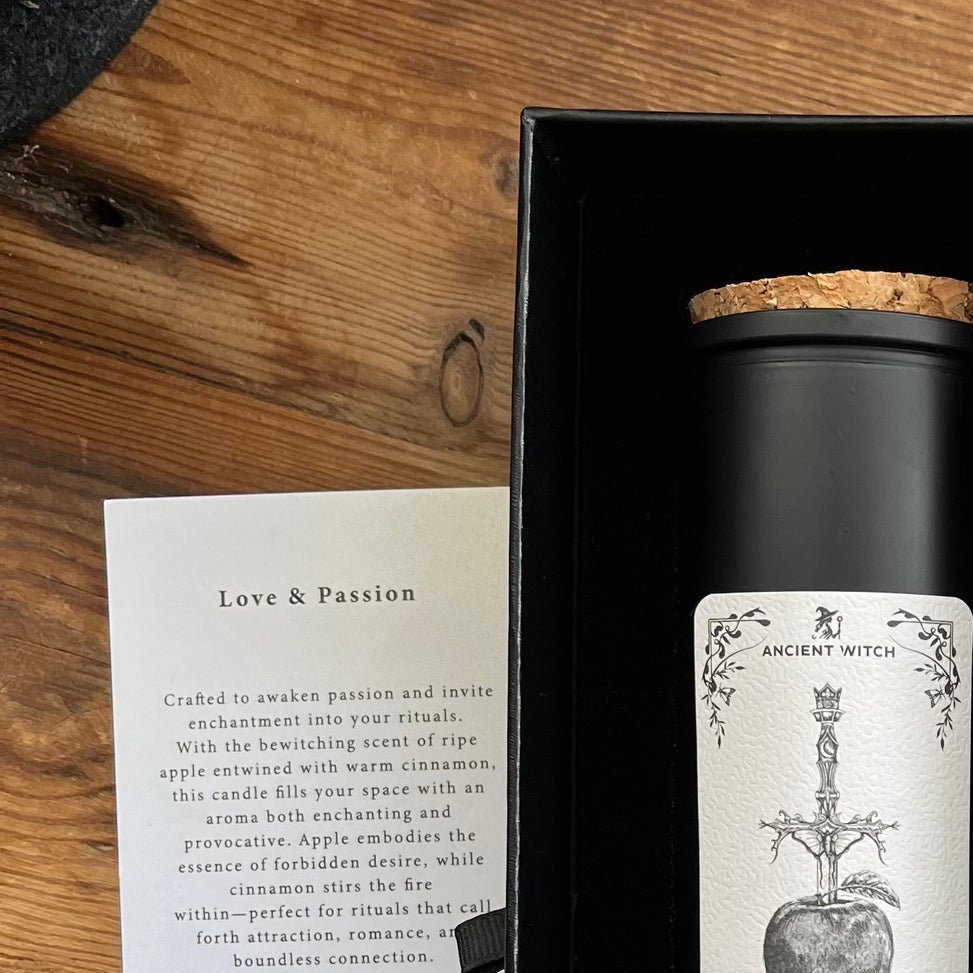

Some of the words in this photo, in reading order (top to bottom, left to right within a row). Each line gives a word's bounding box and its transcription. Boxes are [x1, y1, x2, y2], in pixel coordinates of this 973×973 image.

[218, 590, 277, 608] Love
[288, 587, 306, 605] &
[317, 584, 416, 604] Passion
[761, 644, 835, 657] ANCIENT
[839, 644, 896, 659] WITCH
[163, 690, 226, 707] Crafted
[233, 693, 250, 705] to
[257, 688, 320, 704] awaken
[328, 687, 394, 706] passion
[402, 684, 434, 699] and
[442, 684, 493, 699] invite
[188, 714, 300, 730] enchantment
[308, 713, 343, 726] into
[350, 714, 391, 729] your
[398, 708, 463, 724] rituals.
[175, 739, 217, 754] With
[224, 738, 252, 753] the
[258, 735, 356, 754] bewitching
[363, 735, 409, 749] scent
[416, 732, 436, 747] of
[441, 733, 477, 750] ripe
[159, 763, 206, 781] apple
[213, 760, 293, 777] entwined
[300, 759, 338, 774] with
[345, 762, 394, 773] warm
[401, 758, 496, 772] cinnamon,
[172, 788, 205, 802] this
[211, 785, 268, 801] candle
[275, 784, 307, 799] fills
[314, 787, 355, 802] your
[362, 785, 410, 801] space
[417, 780, 456, 795] with
[464, 783, 484, 794] an
[206, 814, 259, 825] aroma
[265, 808, 305, 824] both
[313, 806, 413, 824] enchanting
[419, 804, 452, 819] and
[184, 834, 292, 854] provocative.
[298, 831, 349, 850] Apple
[356, 829, 441, 845] embodies
[448, 827, 476, 843] the
[178, 862, 243, 874] essence
[249, 856, 268, 872] of
[273, 855, 360, 871] forbidden
[368, 854, 428, 869] desire,
[435, 851, 484, 866] while
[229, 882, 315, 896] cinnamon
[323, 880, 361, 894] stirs
[369, 877, 396, 892] the
[404, 876, 433, 892] fire
[318, 903, 344, 918] for
[351, 901, 409, 917] rituals
[417, 900, 452, 915] that
[459, 898, 491, 914] call
[196, 929, 240, 945] forth
[247, 928, 341, 944] attraction,
[348, 929, 430, 941] romance,
[438, 927, 457, 939] an
[233, 952, 321, 968] boundless
[328, 950, 434, 965] connection.
